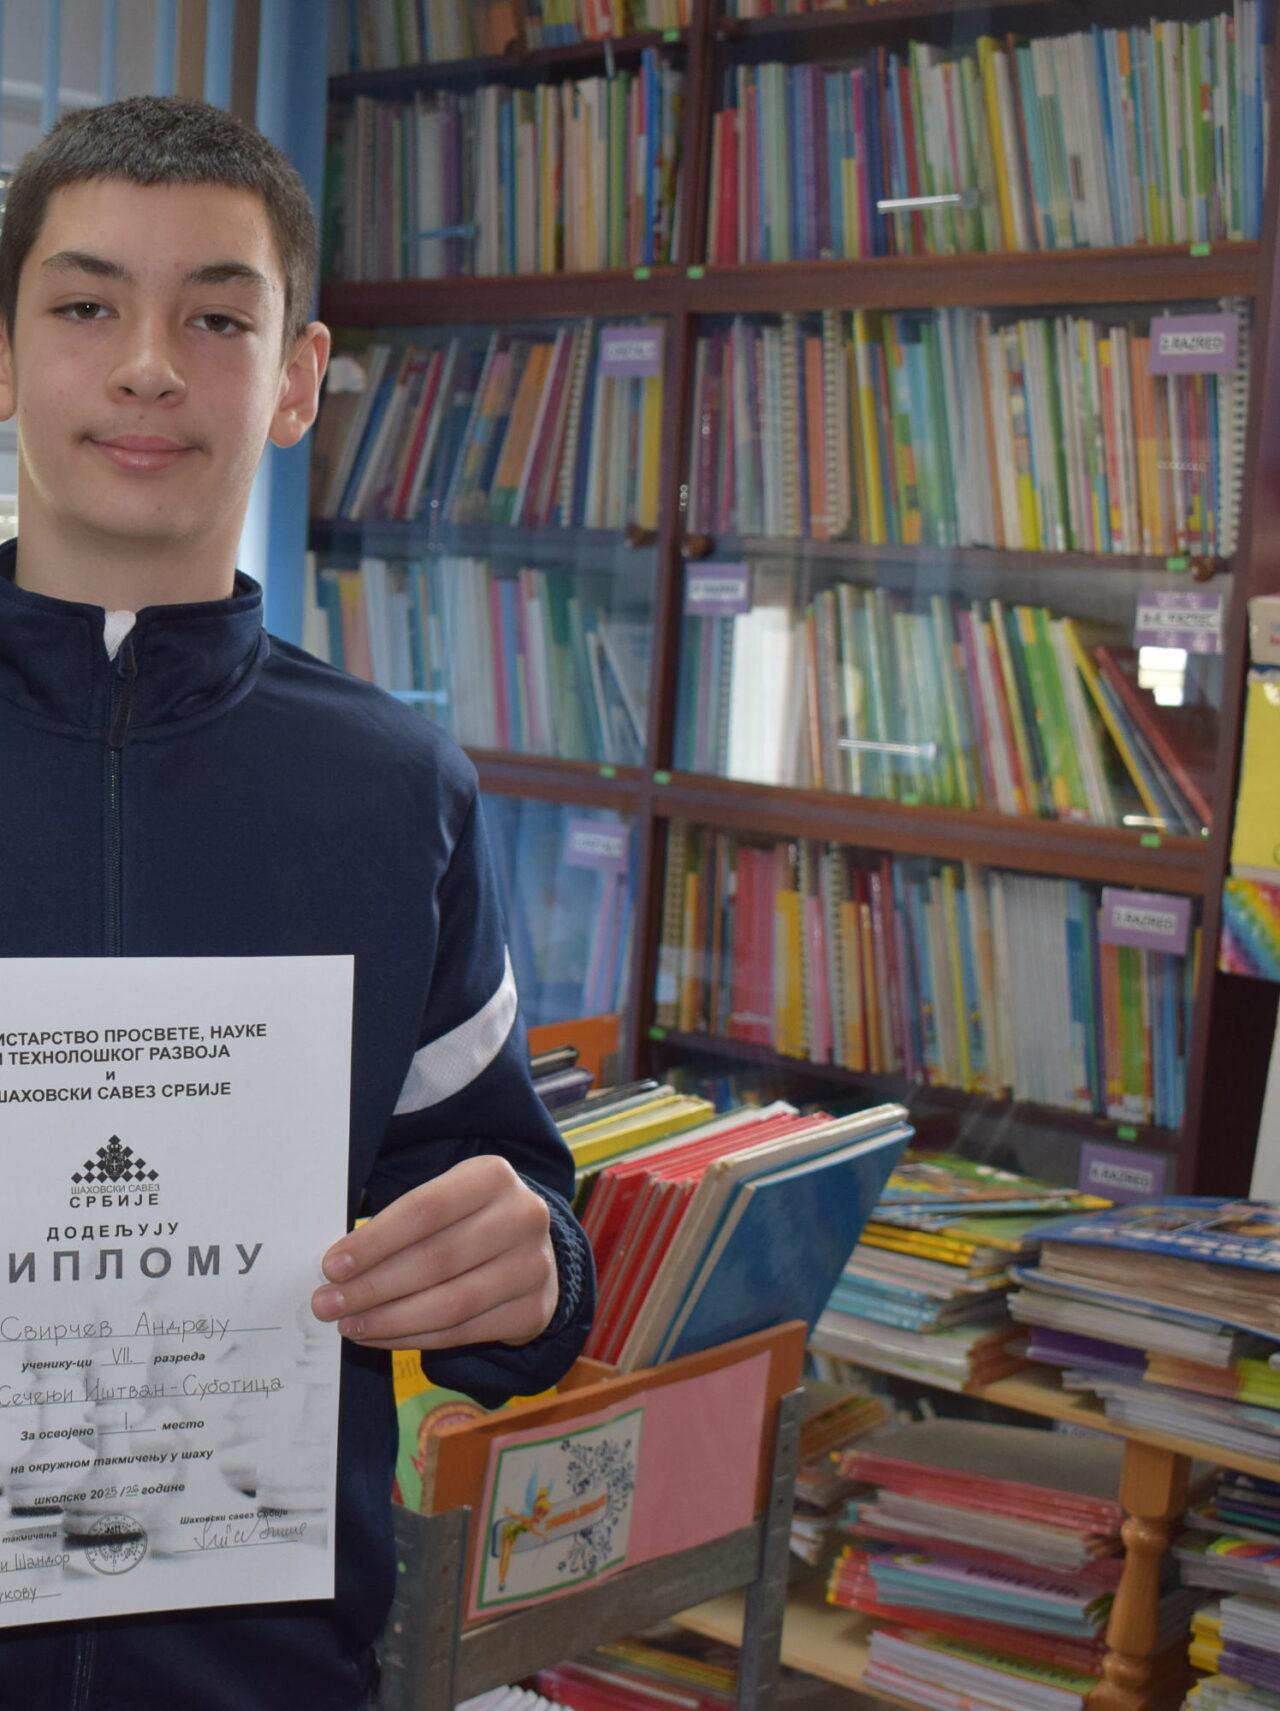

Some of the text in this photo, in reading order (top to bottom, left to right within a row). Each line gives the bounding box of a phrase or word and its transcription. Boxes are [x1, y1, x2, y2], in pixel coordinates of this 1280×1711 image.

[104, 1027, 204, 1043] ПРОСВЕТЕ,
[210, 1024, 267, 1039] НАУКЕ
[8, 1048, 145, 1065] ТЕХНОЛОШКОГ
[149, 1044, 231, 1061] РАЗВОЈА
[97, 1084, 156, 1100] САВЕЗ
[161, 1082, 232, 1098] СРБИЈЕ
[70, 1183, 160, 1194] ШАХОВСКИ САВЕЗ
[69, 1193, 159, 1208] СРБИЈЕ
[46, 1221, 181, 1243] ДОДЕЉУЈУ
[0, 1311, 230, 1346] Свирчев Андреју
[21, 1358, 92, 1373] ученику-ци
[153, 1352, 206, 1367] разреда
[85, 1377, 164, 1401] Иштван
[182, 1374, 284, 1401] Суботица
[20, 1431, 35, 1441] За
[39, 1427, 94, 1440] освојено
[162, 1421, 204, 1431] место
[10, 1449, 214, 1475] на окружном такмичењу у шаху
[34, 1493, 87, 1505] школске
[141, 1484, 185, 1496] године
[180, 1514, 226, 1525] Шаховски
[229, 1512, 254, 1521] савез
[2, 1531, 57, 1545] такмичења
[15, 1553, 70, 1571] Шандор
